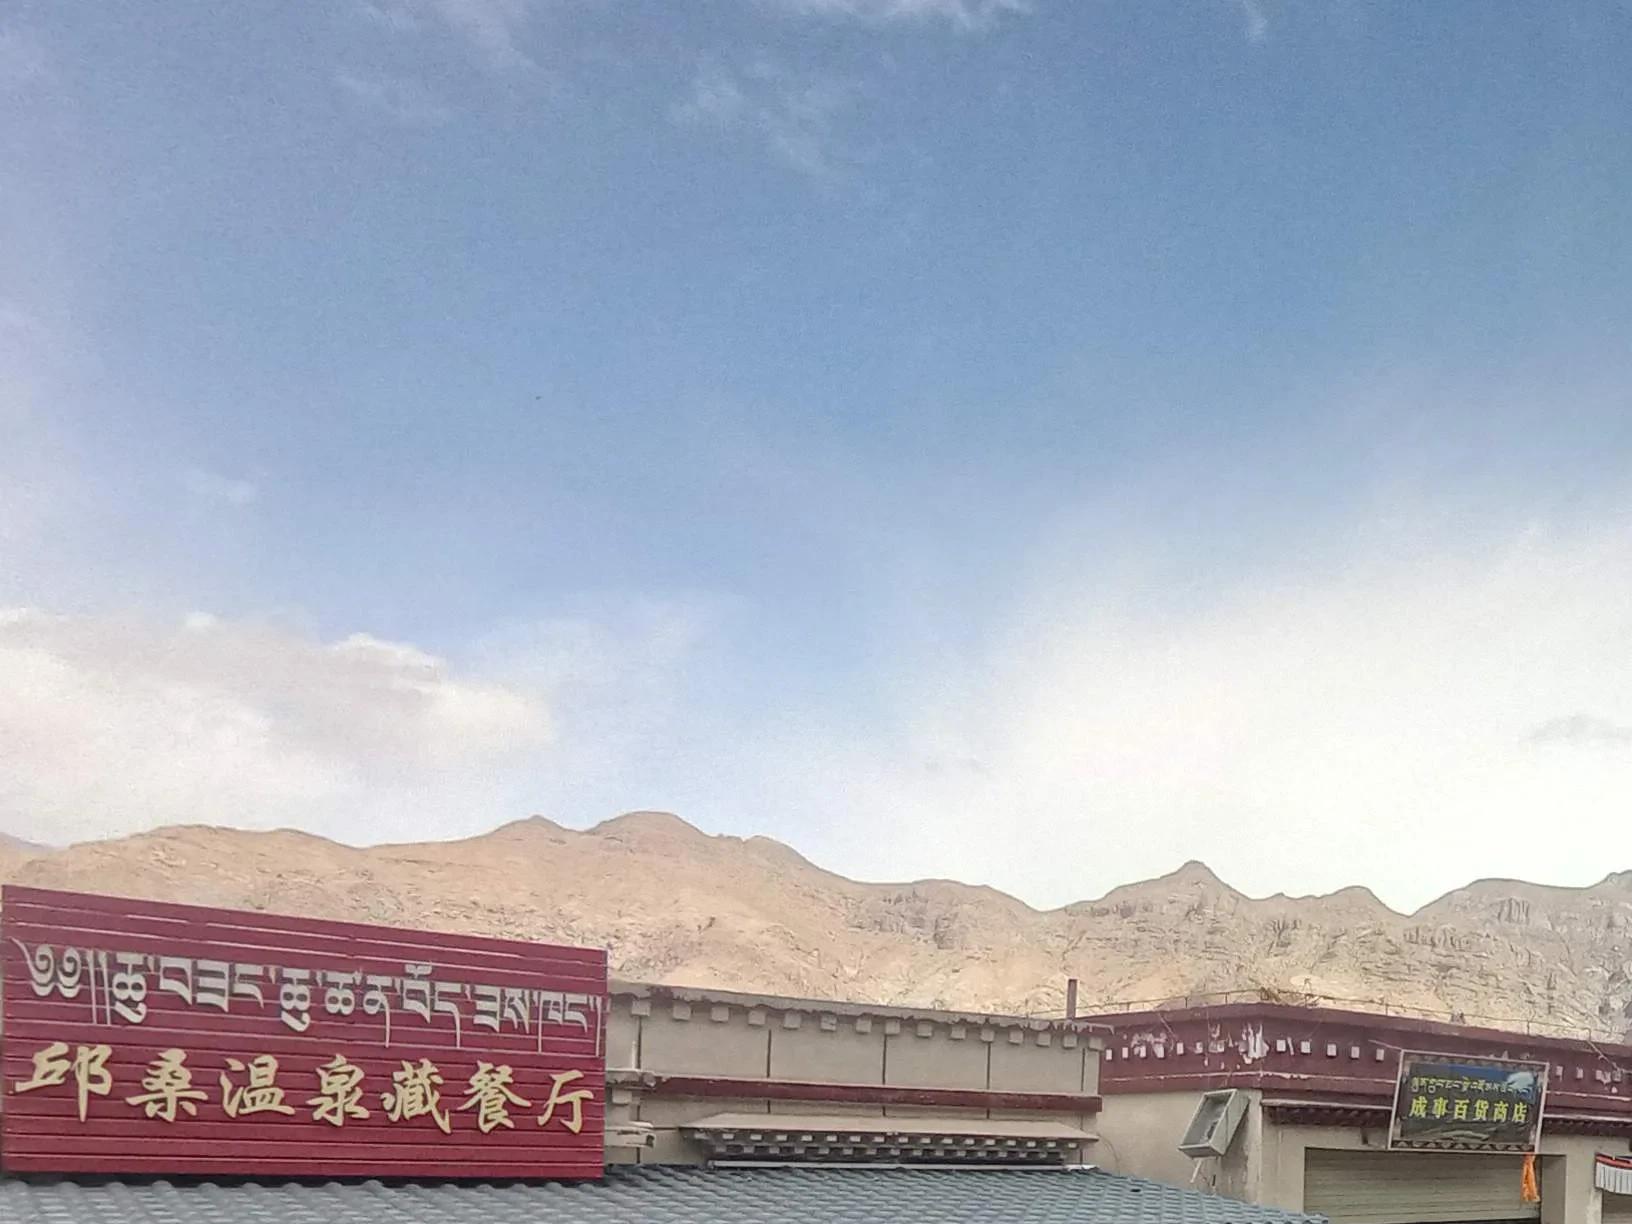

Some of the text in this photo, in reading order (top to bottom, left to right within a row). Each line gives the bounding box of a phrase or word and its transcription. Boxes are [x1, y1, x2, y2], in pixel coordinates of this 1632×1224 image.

[14, 1041, 596, 1135] 邱桑温泉藏餐厅
